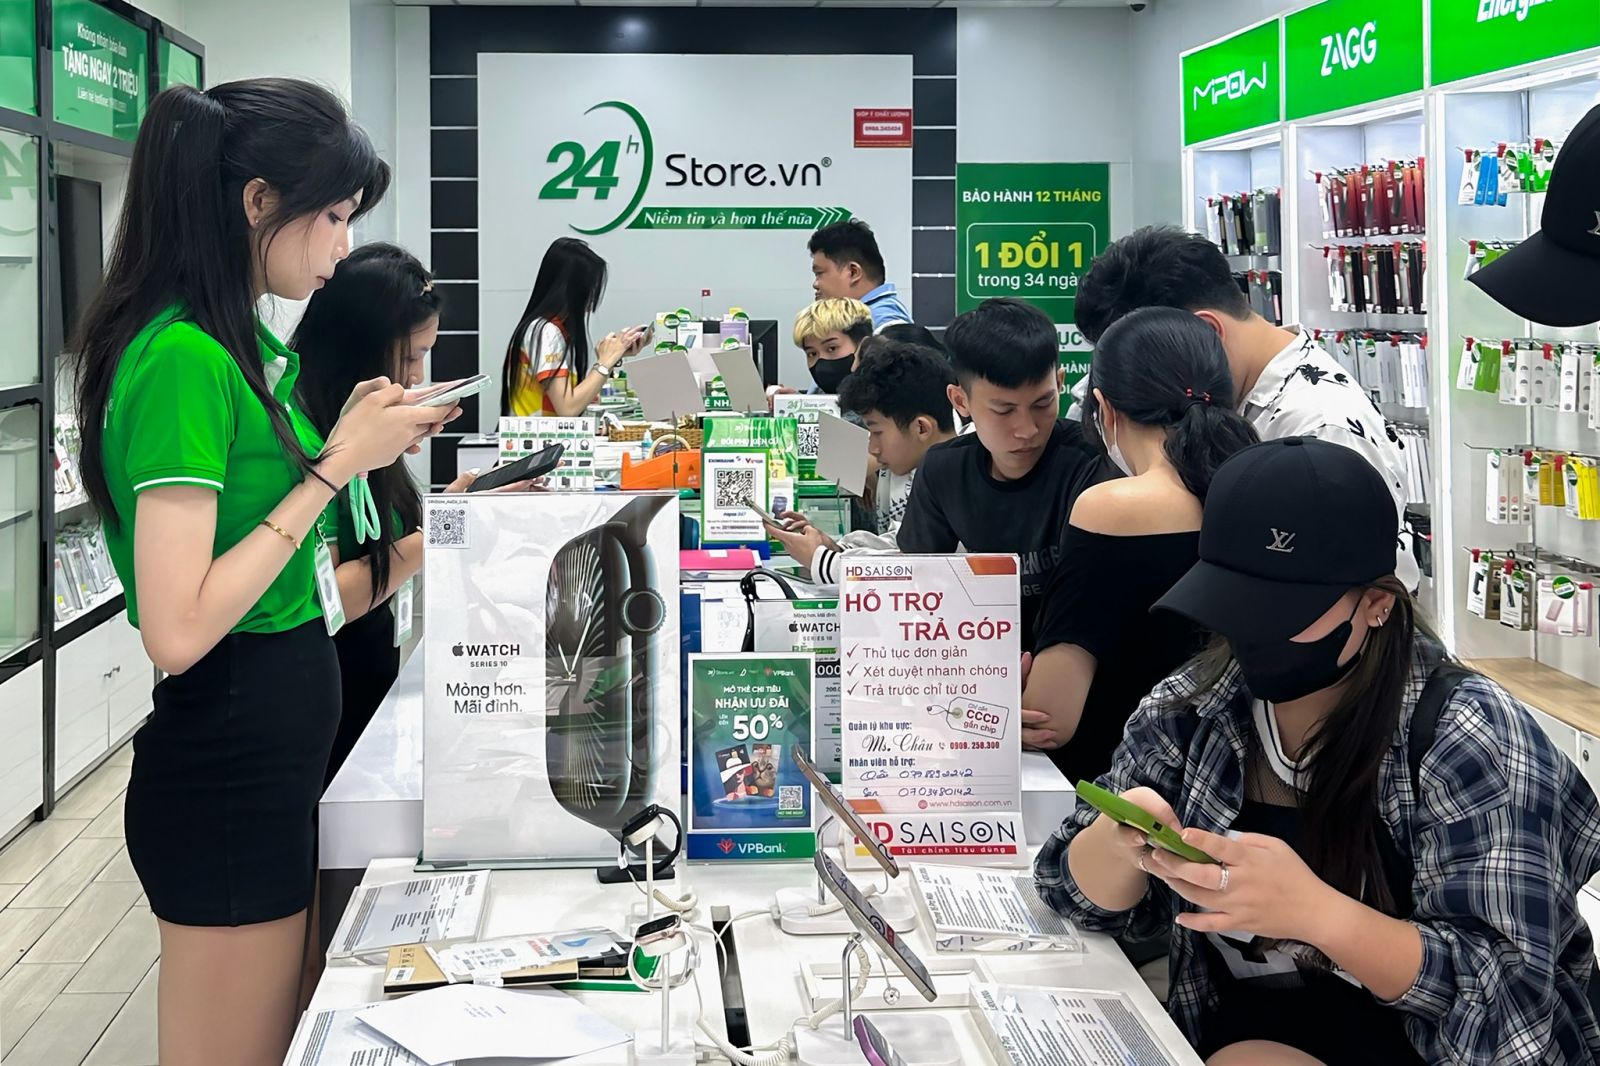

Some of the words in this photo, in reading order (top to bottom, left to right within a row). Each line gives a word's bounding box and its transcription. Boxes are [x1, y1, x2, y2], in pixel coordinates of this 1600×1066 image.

[1320, 22, 1377, 76] ZAGG
[62, 42, 89, 78] TẶNG
[89, 55, 112, 85] NGAY
[112, 66, 118, 88] 2
[963, 189, 991, 203] BẢO
[993, 188, 1033, 203] HÀNH
[1036, 191, 1051, 202] 12
[1053, 188, 1101, 203] THÁNG
[644, 209, 682, 226] Niềm
[687, 211, 705, 225] tin
[711, 212, 726, 225] và
[730, 211, 756, 225] hơn
[761, 210, 784, 225] thế
[788, 213, 813, 225] nữa
[975, 242, 989, 269] 1
[998, 230, 1059, 269] ĐỔI
[1067, 242, 1082, 269] 1
[978, 273, 1020, 289] trong
[1024, 274, 1044, 287] 34
[1049, 271, 1080, 289] ngà
[1057, 331, 1083, 350] ỤC
[846, 566, 863, 576] HD
[864, 566, 913, 576] SAISON
[845, 588, 881, 612] HỖ
[889, 592, 944, 616] TRỢ
[899, 617, 950, 641] TRẢ
[957, 616, 1012, 640] GÓP
[466, 643, 520, 656] WATCH
[863, 647, 888, 658] Thủ
[864, 666, 885, 677] Xét
[888, 666, 923, 679] duyệt
[927, 666, 966, 676] nhanh
[969, 665, 1008, 678] chóng
[864, 685, 885, 696] Trả
[888, 684, 919, 696] trước
[454, 699, 482, 714] Mãi
[715, 696, 748, 711] NHẬN
[769, 695, 789, 708] ĐÃI
[966, 709, 1000, 725] CCCD
[732, 712, 784, 741] 50%
[980, 724, 997, 735] chip
[861, 734, 891, 752] Ms.
[892, 733, 933, 752] Châu
[900, 821, 1016, 844] SAISON
